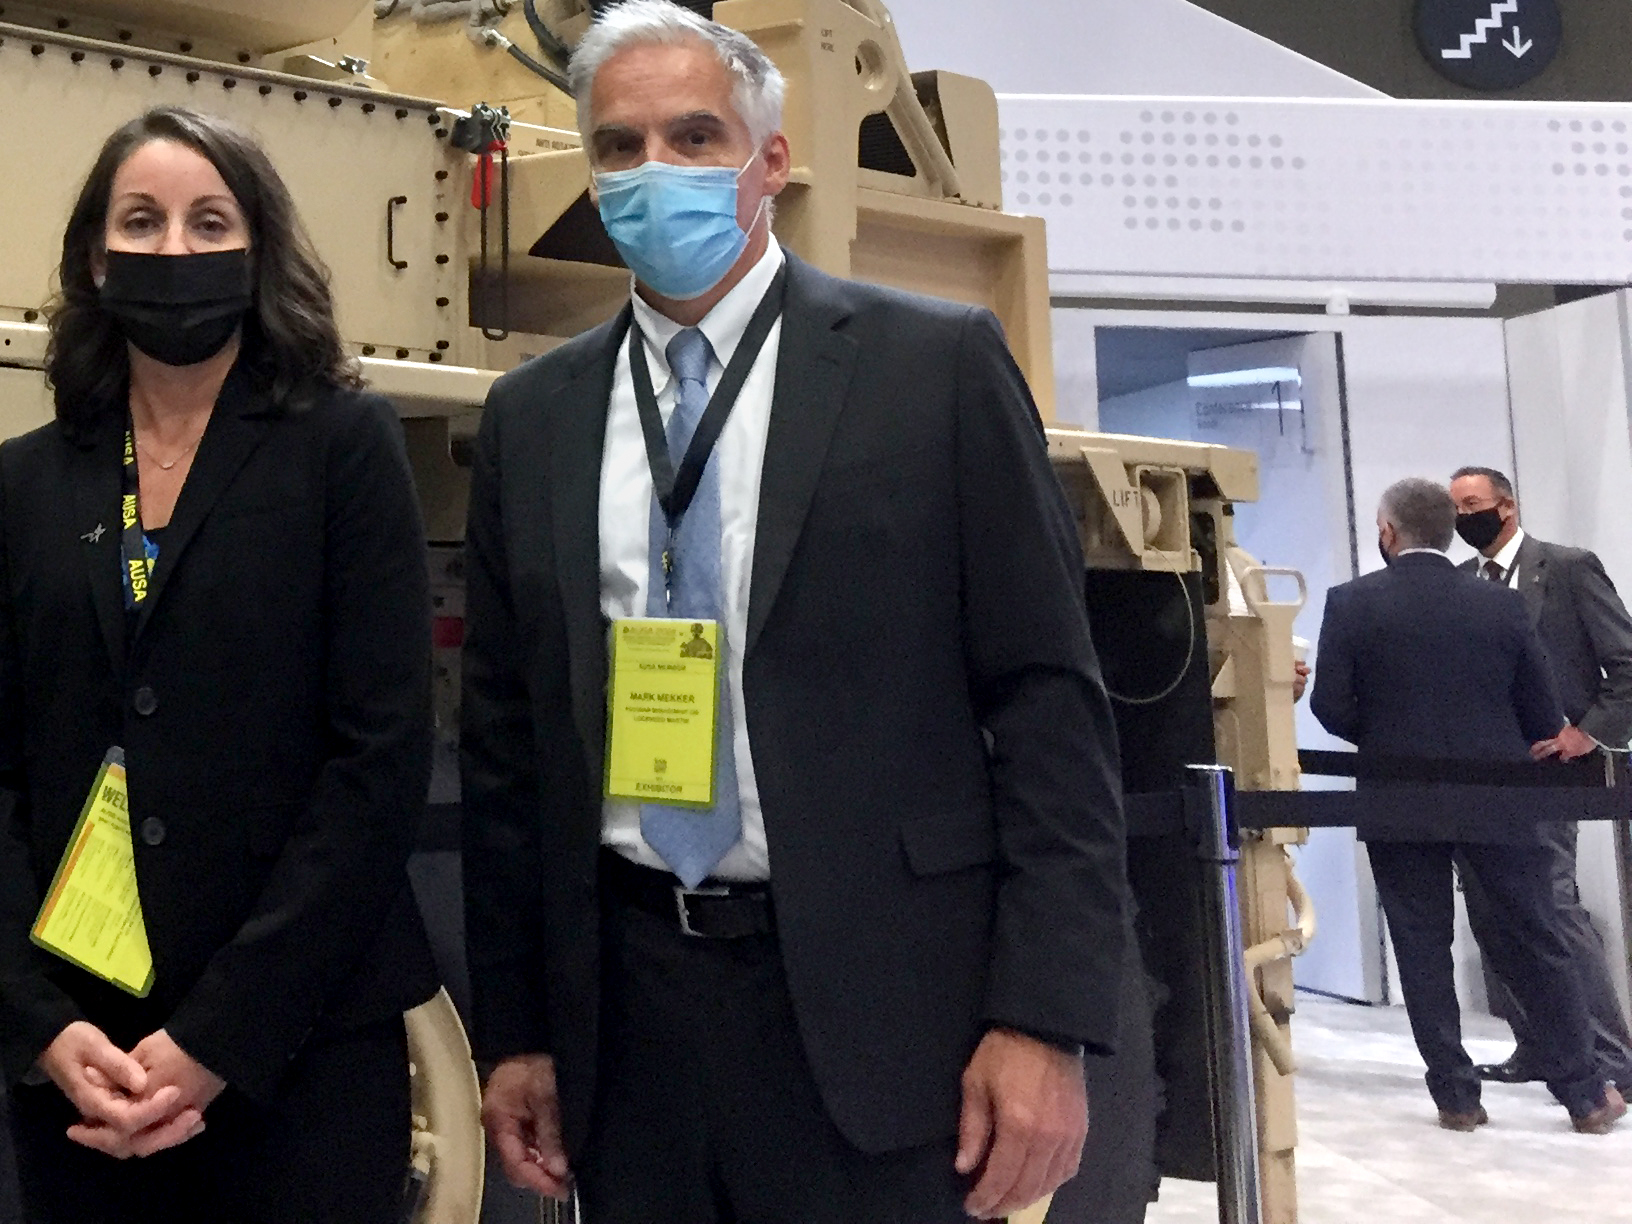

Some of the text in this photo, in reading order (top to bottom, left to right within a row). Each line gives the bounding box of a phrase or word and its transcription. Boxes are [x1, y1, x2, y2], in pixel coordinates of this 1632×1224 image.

[122, 494, 137, 530] AUSA
[1112, 489, 1139, 508] LIFT
[128, 559, 148, 603] AUSA
[629, 691, 655, 701] MARK
[101, 785, 128, 814] WEL
